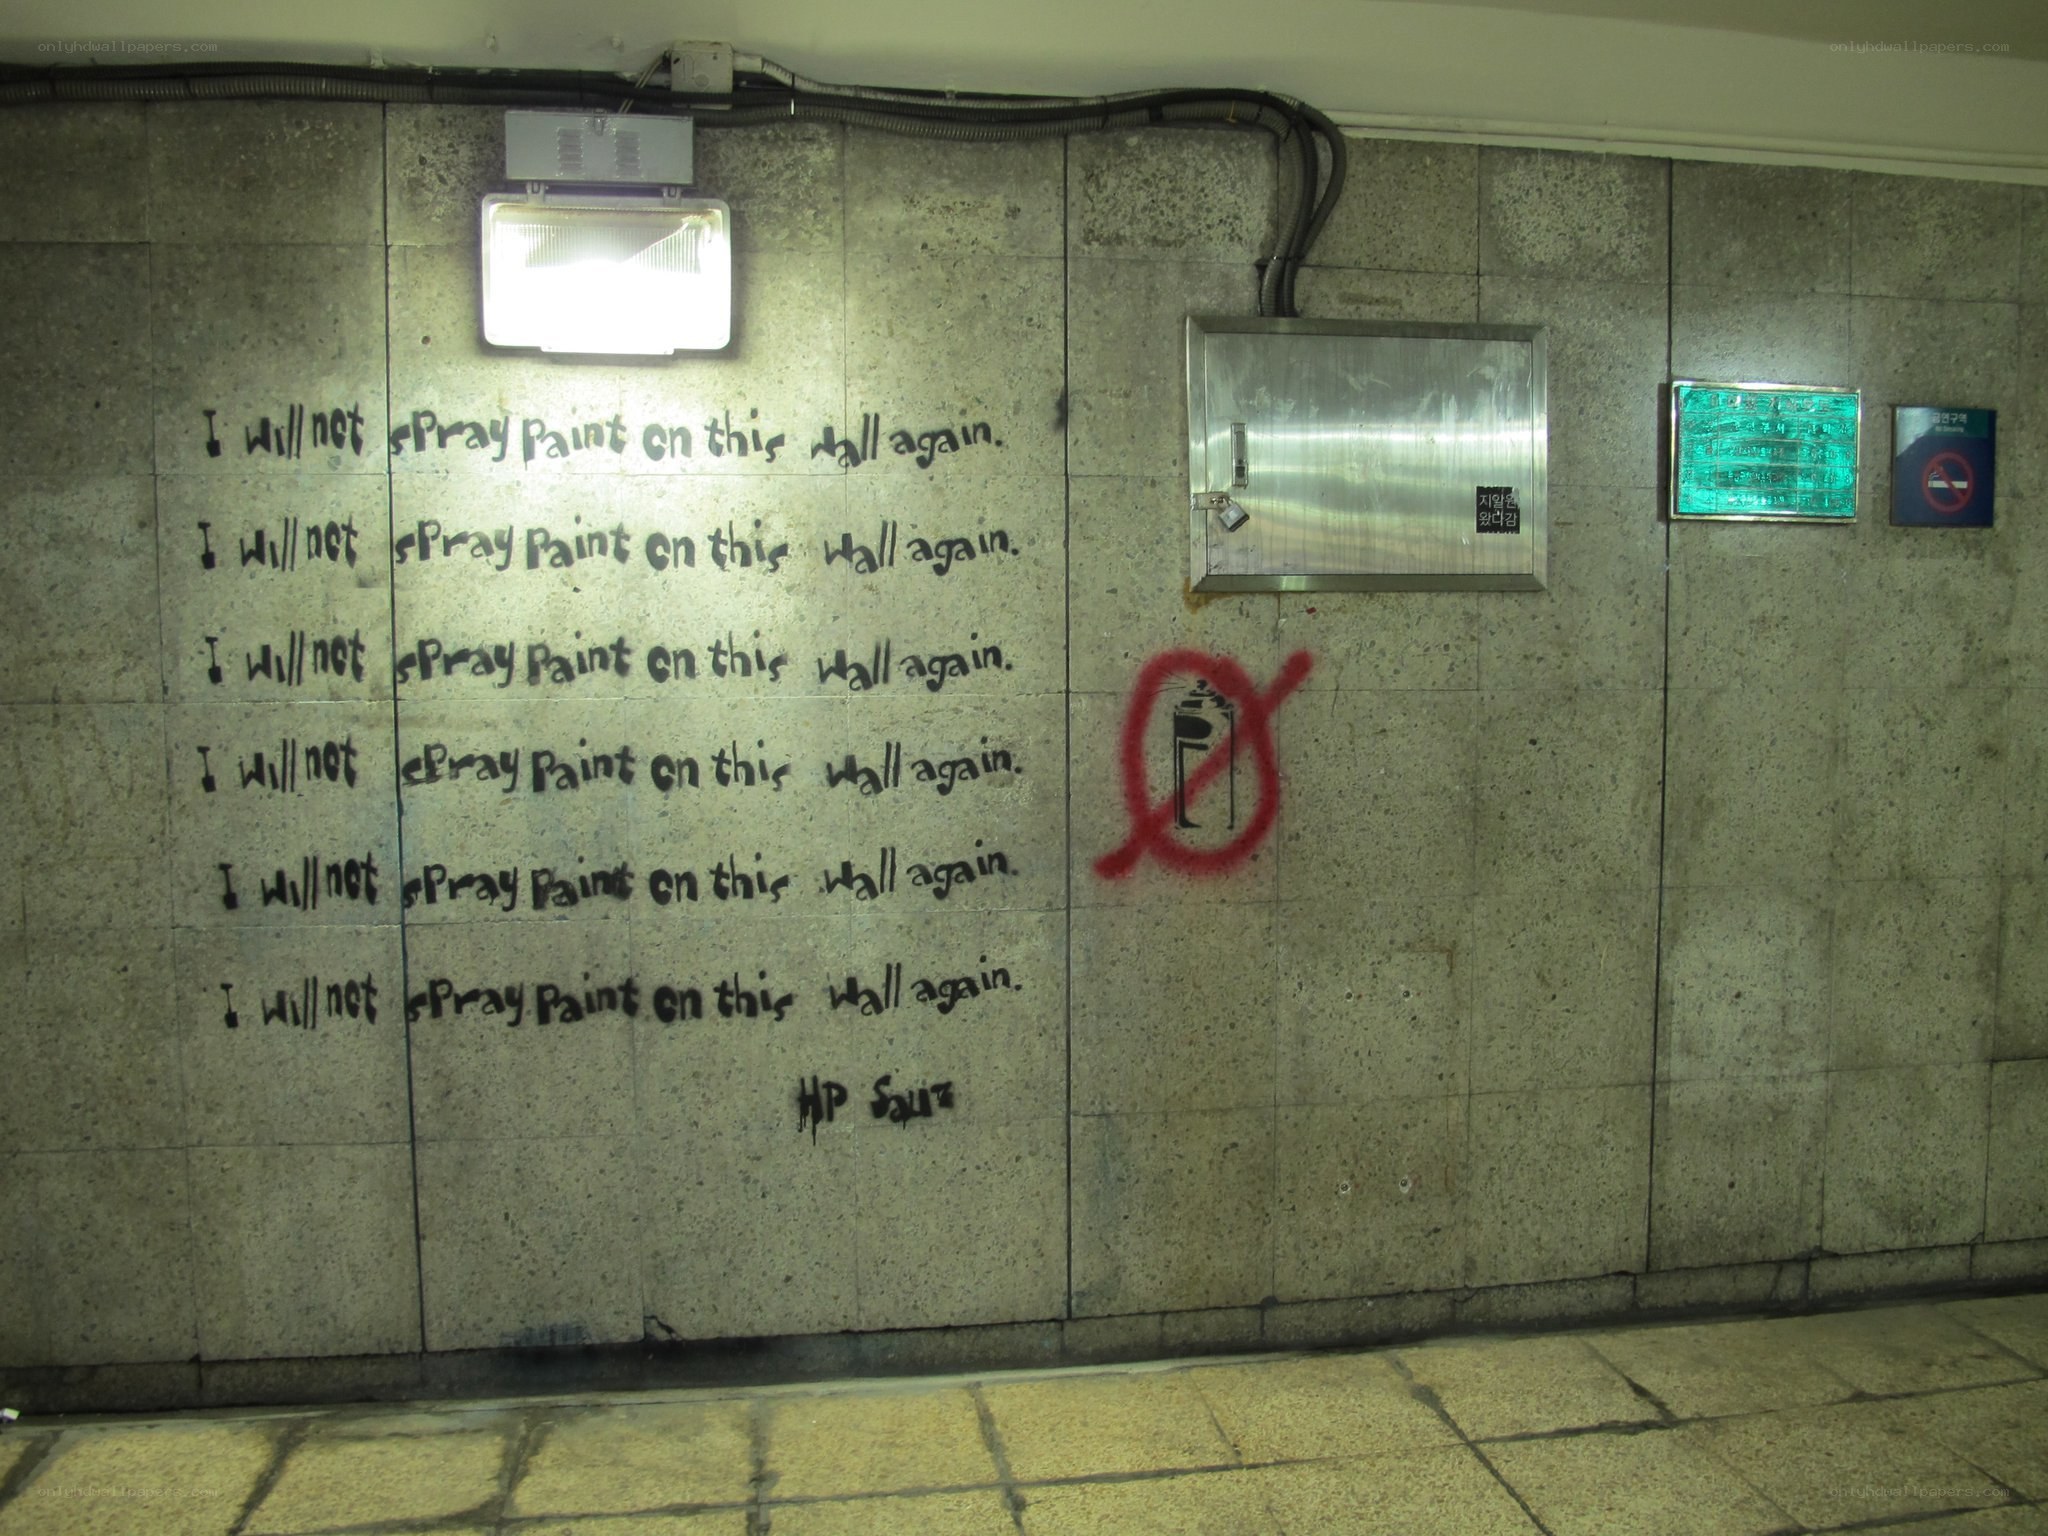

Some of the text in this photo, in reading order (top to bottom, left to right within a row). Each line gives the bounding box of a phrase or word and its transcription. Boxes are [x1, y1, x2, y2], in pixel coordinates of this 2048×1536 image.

[203, 410, 221, 457] I
[245, 403, 303, 459] will
[313, 401, 364, 456] not
[643, 423, 692, 461] on
[705, 408, 785, 463] this
[811, 413, 879, 467] wall
[889, 409, 1003, 469] again.
[198, 522, 215, 569] I
[240, 517, 297, 571] will
[307, 515, 358, 568] not
[646, 532, 695, 570] on
[708, 519, 788, 573] this
[824, 520, 897, 574] wall
[907, 518, 1019, 576] again.
[1479, 511, 1518, 527] 왔다감
[206, 636, 222, 684] I
[247, 631, 304, 686] will
[313, 628, 365, 683] not
[647, 645, 696, 683] on
[708, 630, 788, 682] this
[818, 638, 890, 691] wall
[899, 633, 1013, 692] again.
[197, 745, 216, 793] I
[238, 737, 296, 793] will
[305, 734, 358, 788] not
[650, 754, 700, 792] on
[711, 739, 794, 791] this
[826, 741, 901, 795] wall
[910, 736, 1022, 796] again.
[219, 863, 237, 910] I
[260, 855, 318, 911] will
[326, 851, 378, 905] not
[649, 869, 698, 905] on
[710, 852, 789, 903] this
[823, 846, 896, 901] wall
[906, 839, 1019, 900] again.
[220, 983, 238, 1029] I
[262, 975, 318, 1029] will
[326, 972, 378, 1025] not
[653, 985, 702, 1023] on
[713, 970, 793, 1021] this
[829, 962, 901, 1016] wall
[910, 954, 1022, 1015] again.
[798, 1074, 848, 1135] HP
